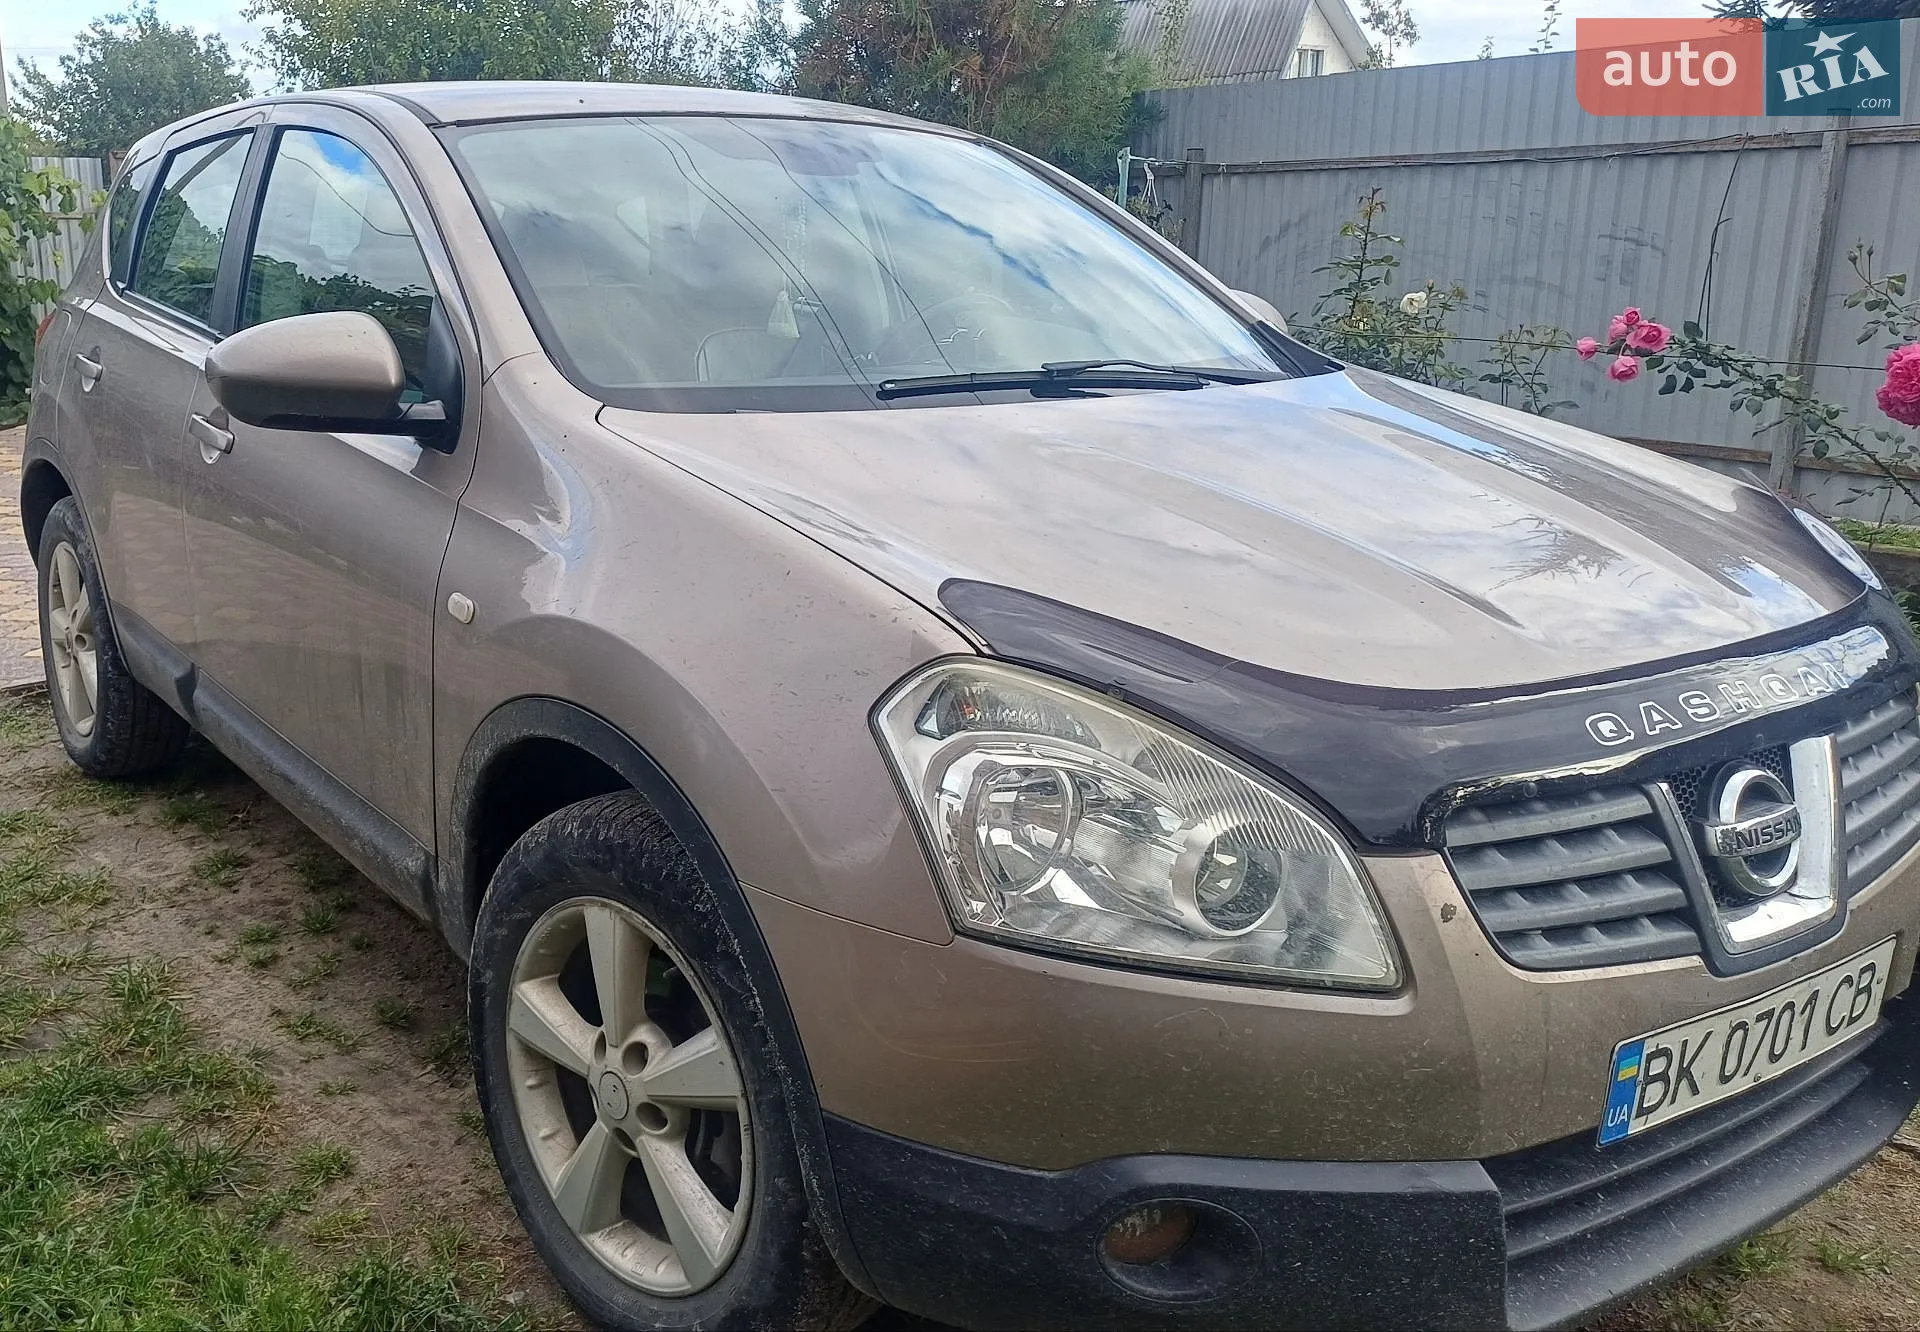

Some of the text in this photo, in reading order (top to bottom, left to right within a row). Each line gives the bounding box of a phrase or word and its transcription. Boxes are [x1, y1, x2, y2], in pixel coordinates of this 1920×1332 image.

[1585, 663, 1849, 745] QASHQAI
[1636, 961, 1876, 1119] BK 0701 CB
[1607, 1107, 1629, 1128] UA
